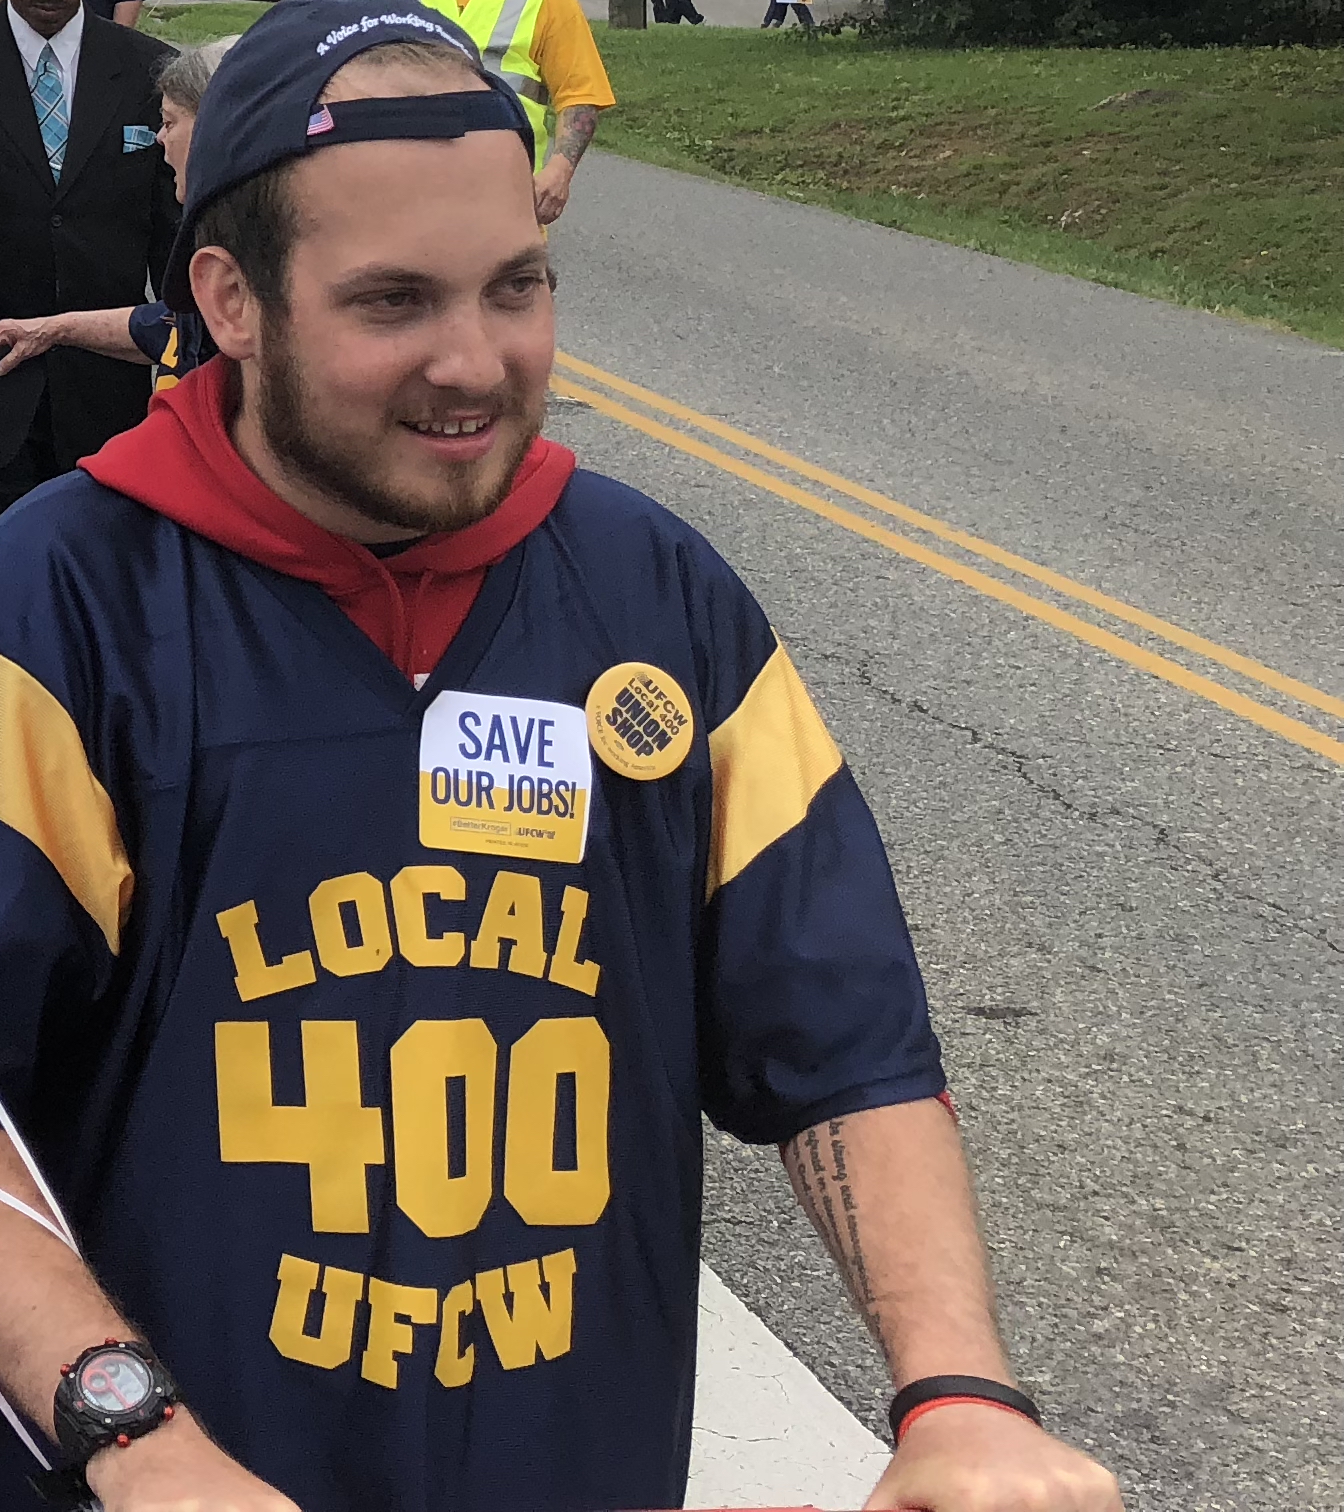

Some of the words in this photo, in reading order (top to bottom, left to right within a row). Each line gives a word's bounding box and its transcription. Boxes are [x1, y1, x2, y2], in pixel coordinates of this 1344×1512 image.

[326, 23, 359, 45] Voice
[360, 16, 380, 33] for
[380, 13, 434, 32] Working
[615, 687, 673, 752] UNION
[628, 678, 660, 712] Local
[659, 714, 680, 736] 400
[644, 679, 688, 726] UFCW
[458, 710, 556, 769] SAVE
[605, 707, 654, 757] SHOP
[430, 766, 495, 810] OUR
[504, 773, 577, 820] JOBS!
[216, 865, 601, 1002] LOCAL
[215, 1016, 610, 1238] 400
[269, 1248, 577, 1389] UFCW
